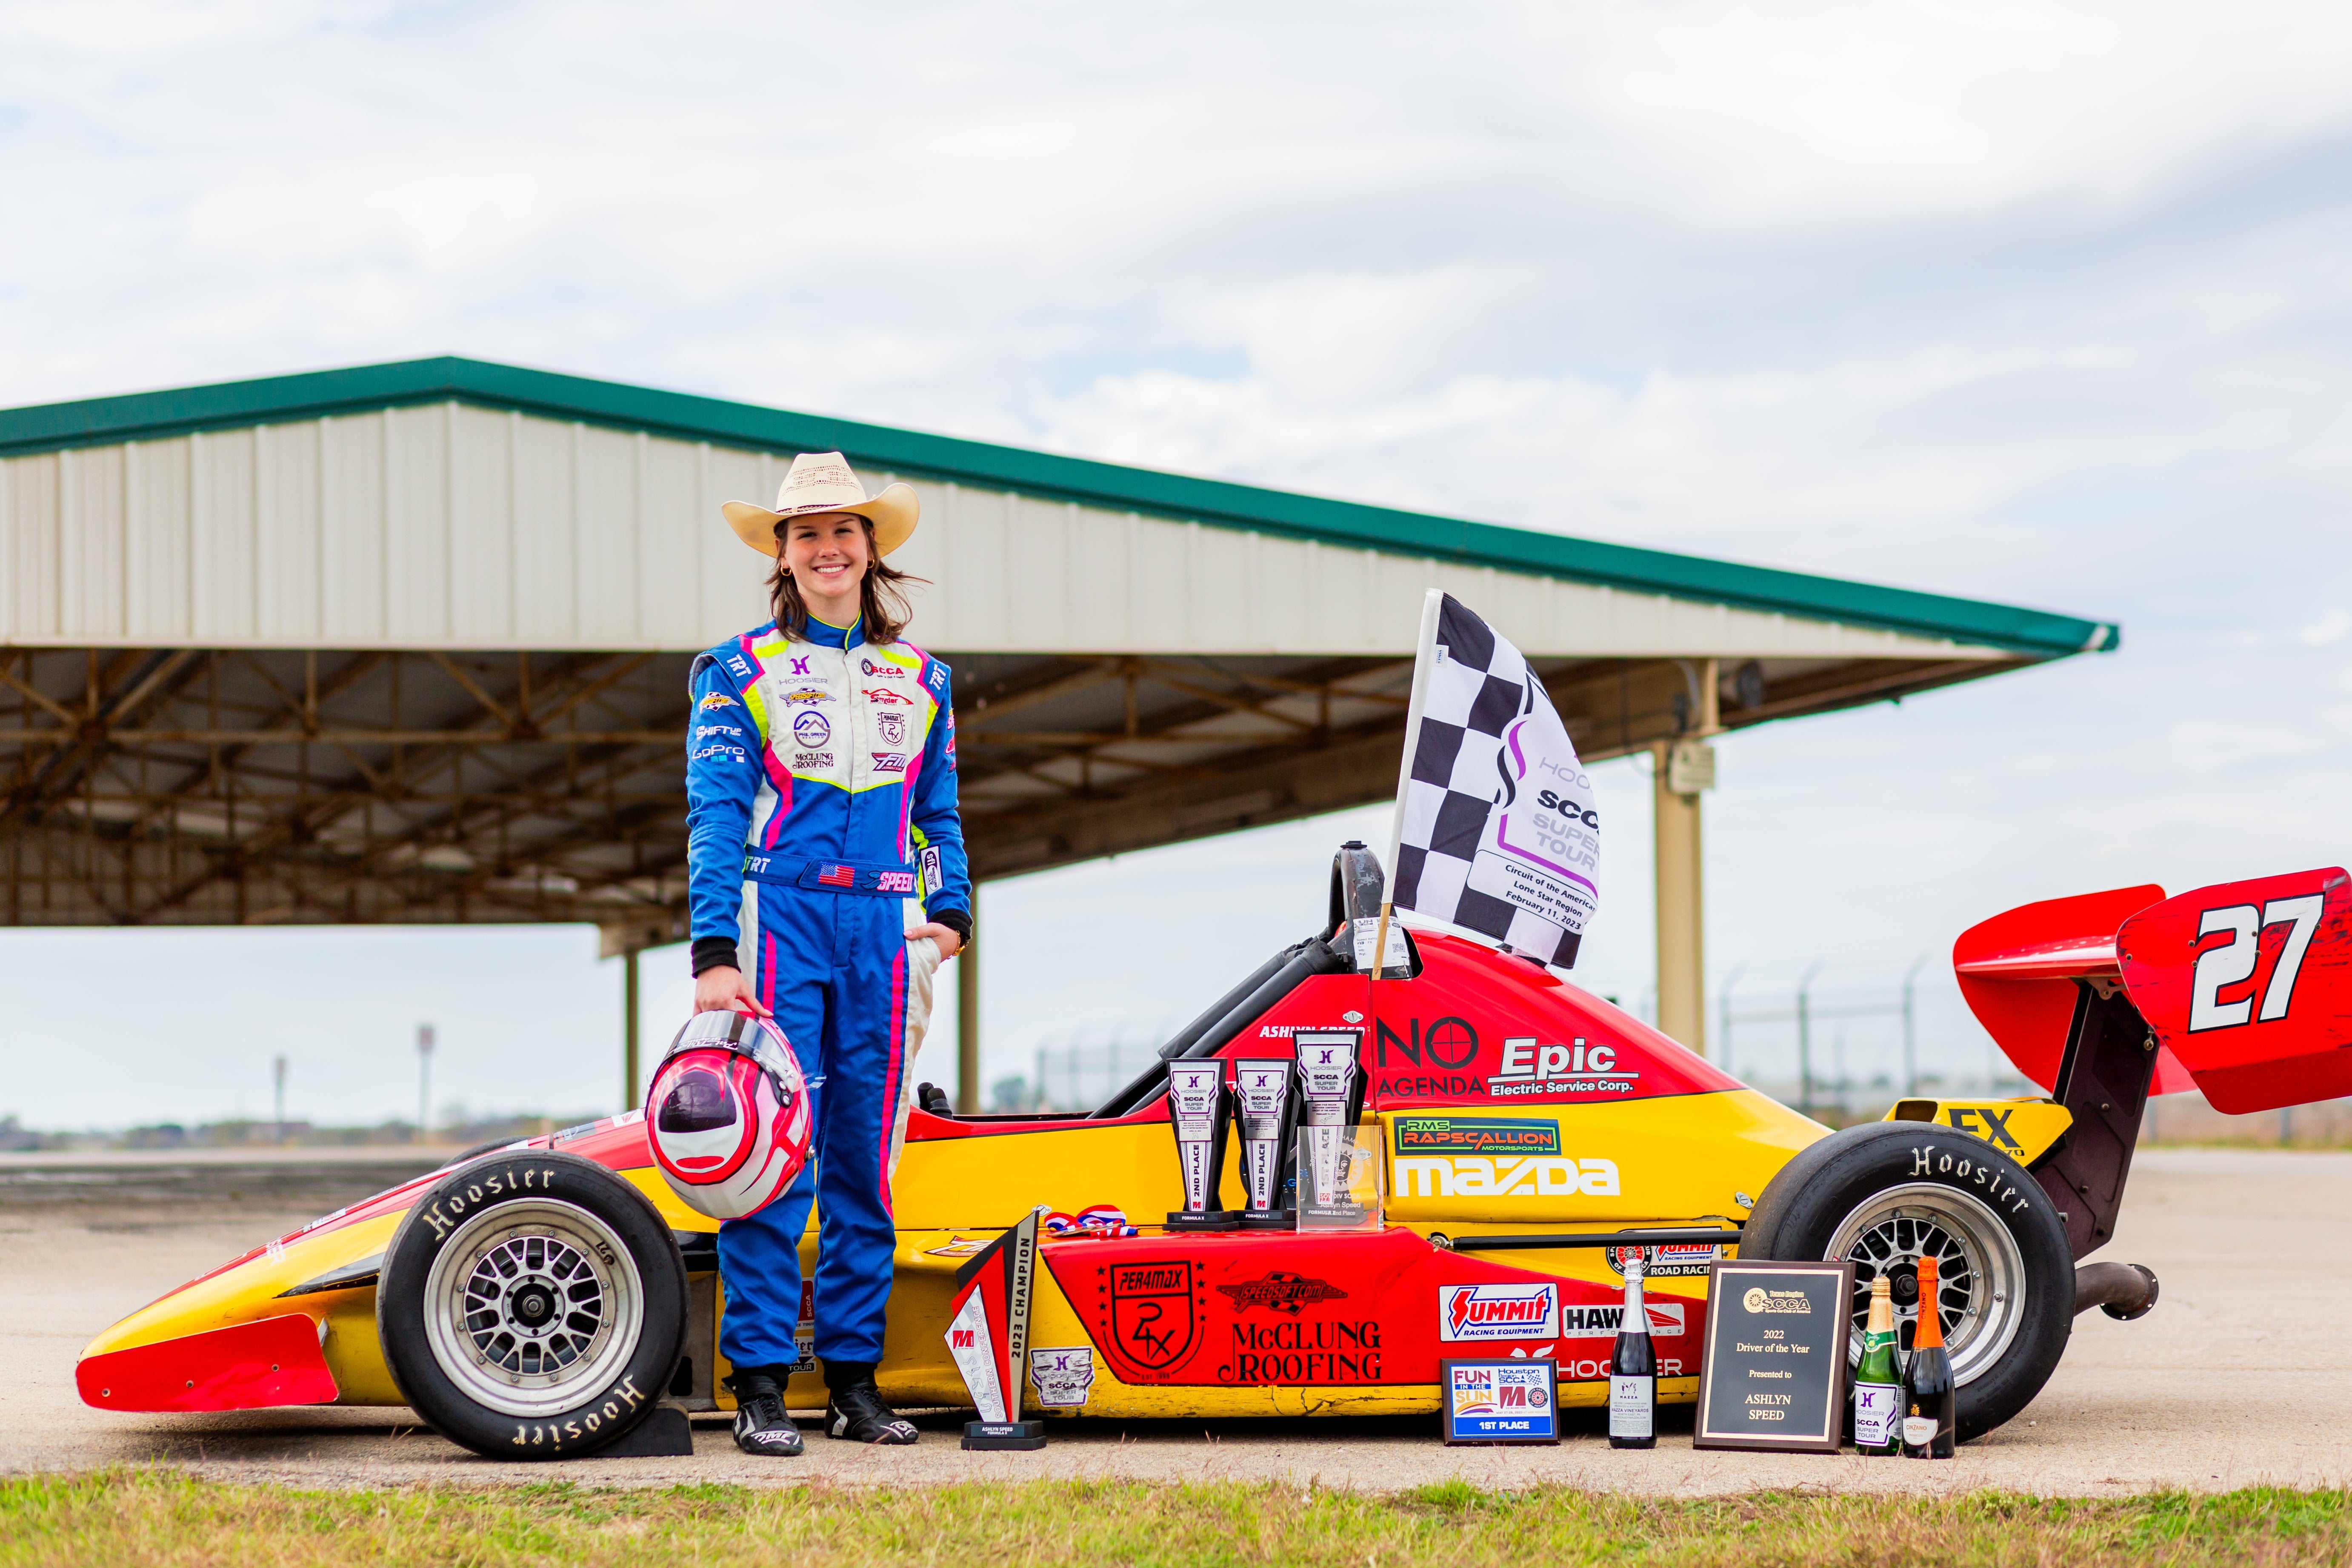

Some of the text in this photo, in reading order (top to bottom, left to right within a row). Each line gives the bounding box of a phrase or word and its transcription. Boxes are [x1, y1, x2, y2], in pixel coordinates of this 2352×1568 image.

[726, 654, 752, 677] TRT
[872, 666, 904, 674] SCCA
[929, 663, 946, 691] TRT
[696, 725, 731, 740] SHIFT
[692, 745, 745, 760] GoPro
[792, 760, 834, 770] ROOFING
[1537, 789, 1600, 835] SCC
[1536, 831, 1596, 873] TOUR
[746, 856, 771, 874] TRT
[878, 872, 914, 892] SPEED
[1505, 864, 1534, 882] Circuit
[1535, 878, 1545, 886] of
[1546, 883, 1560, 894] the
[1513, 880, 1583, 918] Lone Star Region
[1506, 890, 1582, 931] February 11, 2023
[2186, 890, 2326, 1035] 27
[1376, 1016, 1480, 1071] NO
[1498, 1037, 1617, 1081] Epic
[1376, 1075, 1486, 1098] AGENDA
[1490, 1080, 1634, 1097] Electric Service Corp.
[1408, 1121, 1449, 1130] RMS
[1947, 1108, 2022, 1148] FX
[1404, 1132, 1553, 1150] RAPSCALLION
[1907, 1145, 2029, 1214] Hoosier
[422, 1168, 556, 1242] Hoosier
[1614, 1262, 1622, 1270] OF
[1651, 1266, 1681, 1275] ROAD
[1011, 1237, 1030, 1359] 2023 CHAMPION
[1761, 1298, 1811, 1310] SCCA
[1566, 1308, 1624, 1330] HAW
[1763, 1330, 1784, 1339] 2022
[1736, 1342, 1810, 1353] Driver of the Year
[972, 1305, 1003, 1419] SOUTHERN CONFERENCE
[1217, 1353, 1382, 1382] ROOFING
[1556, 1359, 1683, 1378] HOOER
[1454, 1370, 1491, 1383] FUN
[1749, 1369, 1792, 1379] Presented to
[1455, 1390, 1492, 1403] SUN
[1744, 1394, 1792, 1405] ASHLYN
[512, 1374, 646, 1452] Hoosier
[1749, 1410, 1785, 1420] SPEED
[1479, 1421, 1530, 1430] 1ST PLACE
